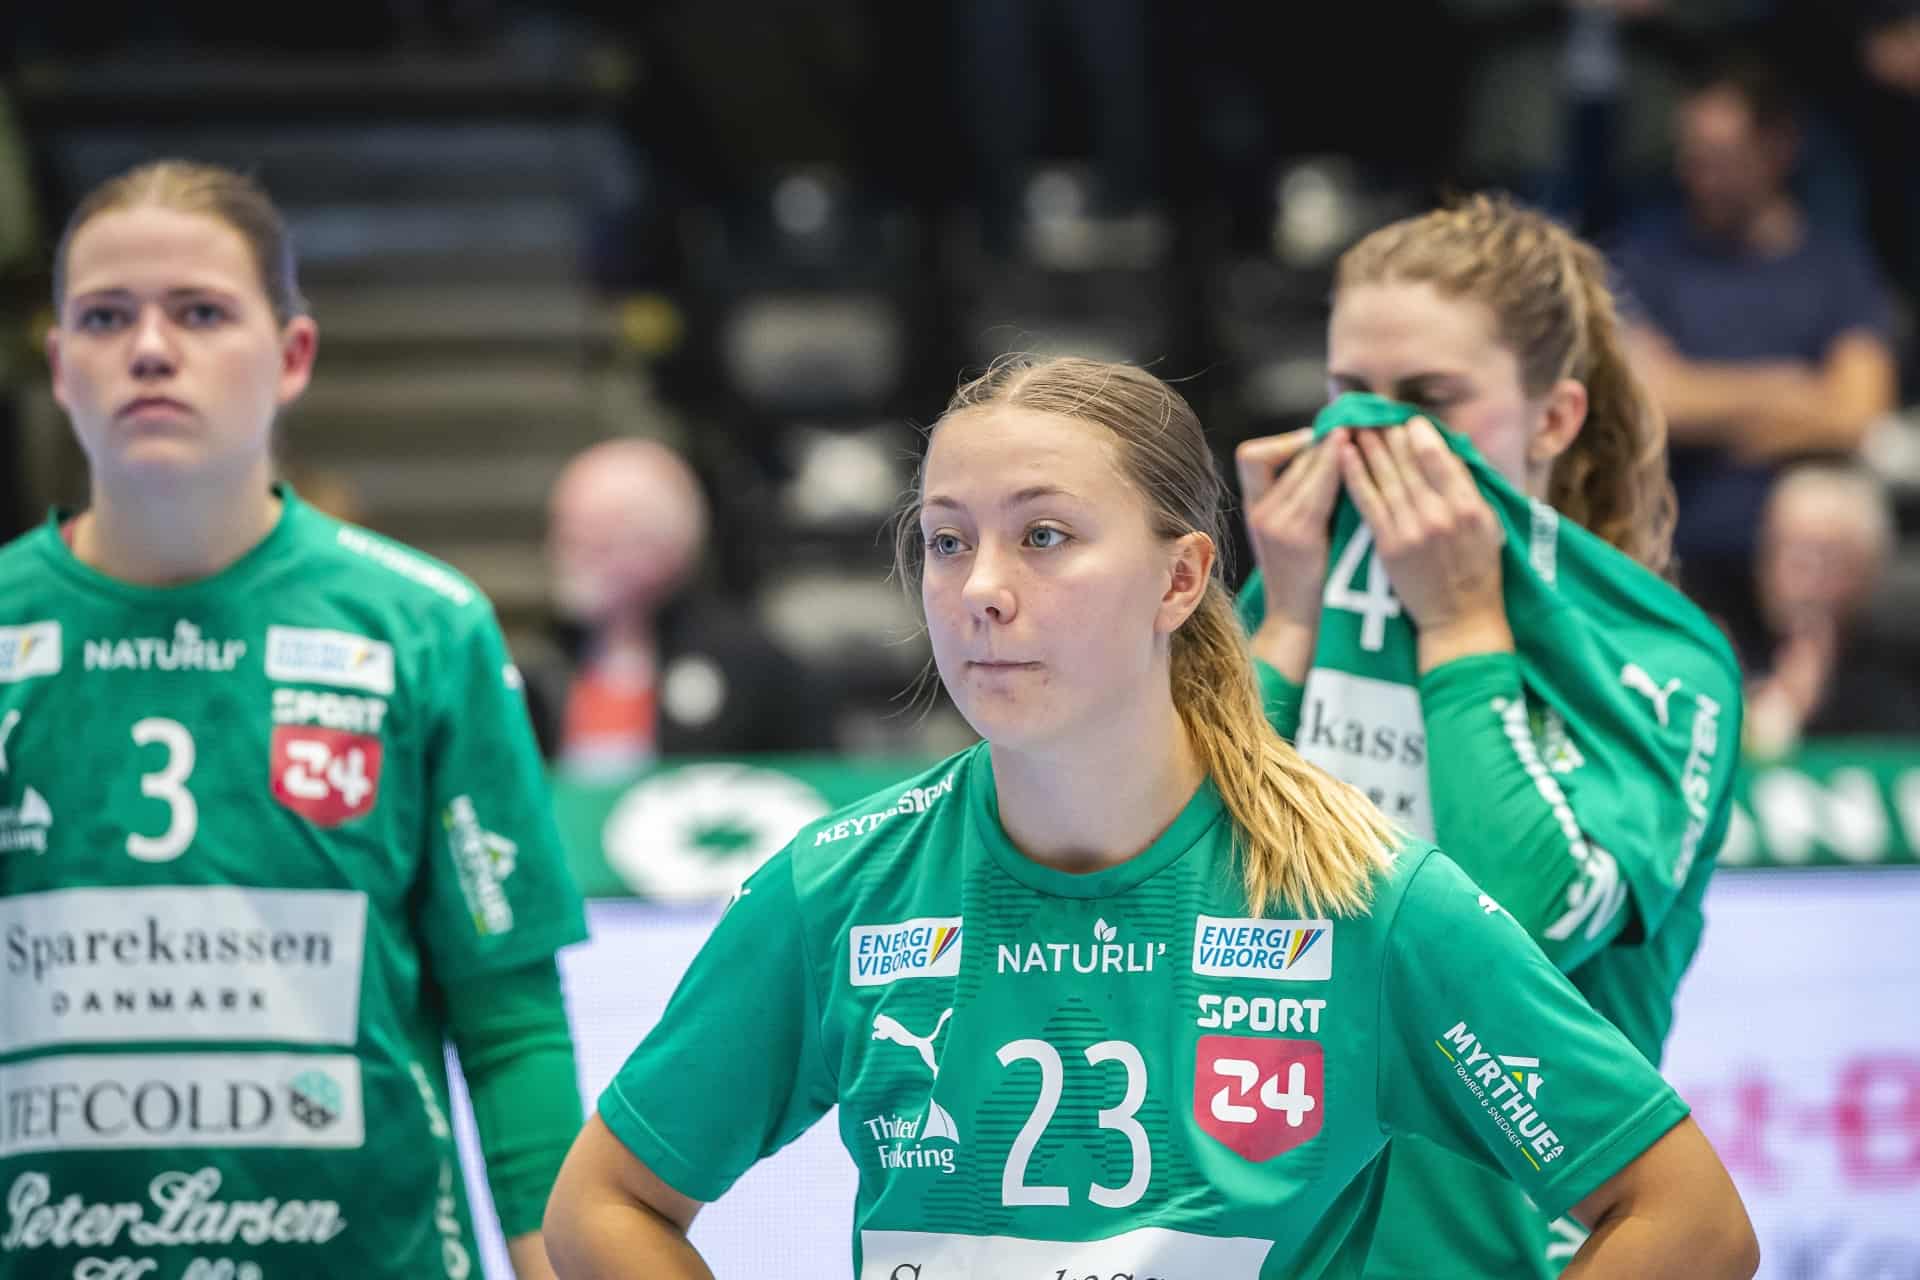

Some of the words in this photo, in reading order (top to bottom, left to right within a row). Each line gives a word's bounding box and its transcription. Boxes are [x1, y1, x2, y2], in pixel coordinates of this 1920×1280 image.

[1323, 521, 1401, 652] 4
[272, 687, 388, 734] SPORT
[125, 716, 199, 864] 3
[283, 739, 373, 808] 24
[4, 915, 333, 983] Sparekassen
[857, 948, 928, 977] VIBORG
[858, 927, 932, 955] ENERGI
[1200, 946, 1286, 970] VIBORG
[1202, 926, 1292, 949] ENERGI
[1197, 994, 1327, 1034] SPORT
[1210, 1058, 1315, 1128] 24
[1443, 1021, 1560, 1156] MYRTHUE
[1453, 1061, 1485, 1099] TØMRER
[1487, 1106, 1522, 1148] SNEDKER
[995, 1038, 1152, 1209] 23
[129, 1167, 347, 1246] Larsen
